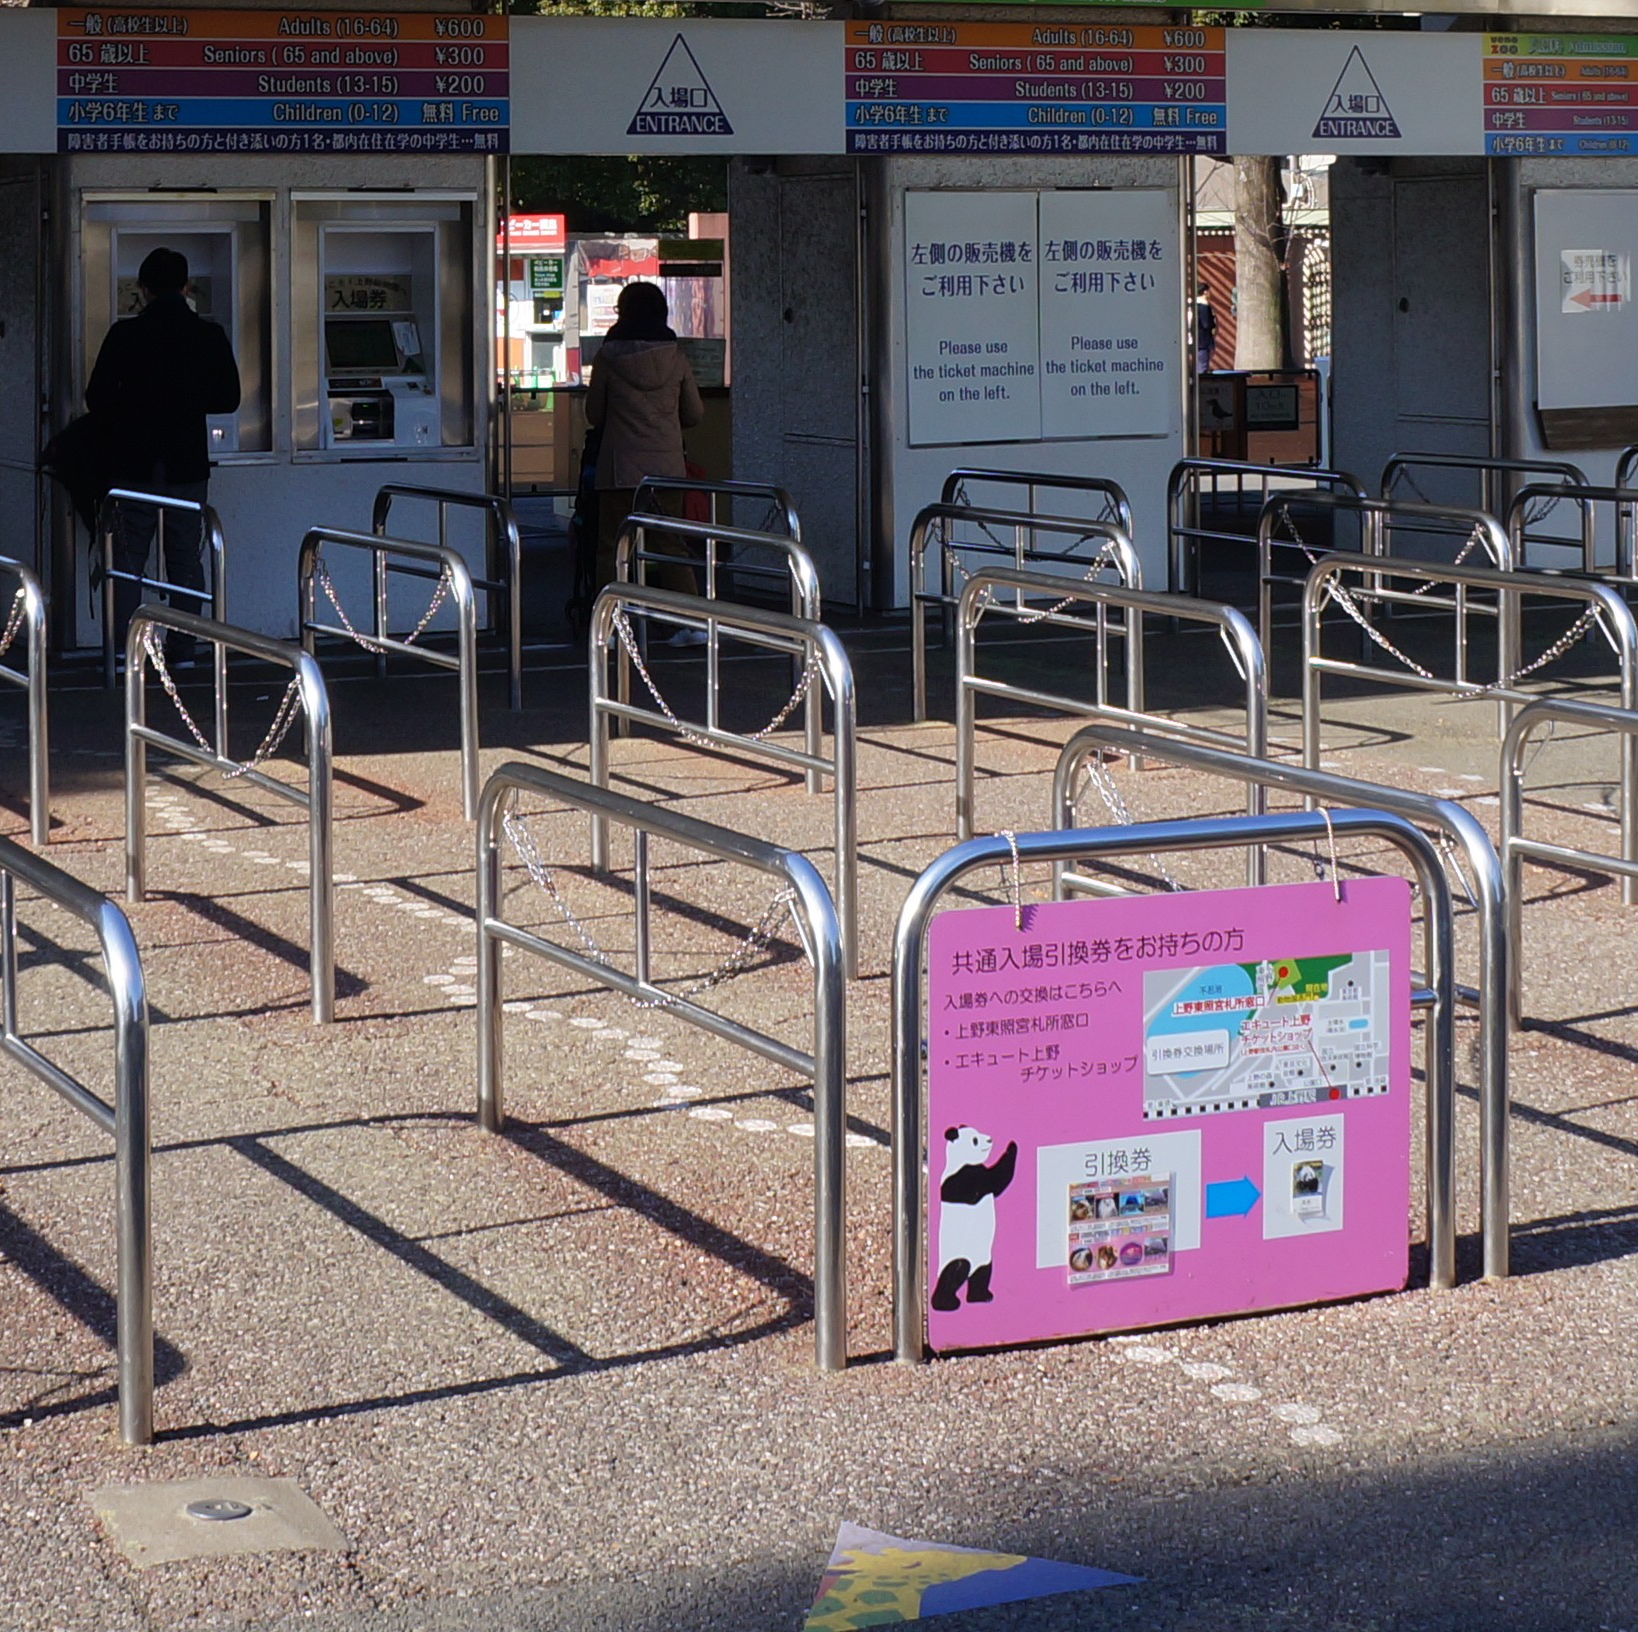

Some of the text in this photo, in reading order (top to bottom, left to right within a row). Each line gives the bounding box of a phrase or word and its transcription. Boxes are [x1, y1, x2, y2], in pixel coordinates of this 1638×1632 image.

[69, 15, 101, 32] 一般
[279, 17, 330, 36] Adults
[337, 18, 399, 38] (16-64)
[435, 19, 484, 38] ¥600
[855, 27, 883, 43] 一般
[1033, 29, 1076, 45] Adults
[1081, 30, 1133, 47] (16-64)
[1164, 31, 1205, 47] ¥600
[68, 45, 93, 63] 65
[100, 45, 150, 64] 歳以上
[204, 46, 265, 64] Seniors
[311, 47, 339, 64] and
[345, 47, 399, 67] above)
[435, 48, 484, 66] ¥300
[855, 53, 876, 69] 65
[882, 53, 923, 70] 歳以上
[970, 54, 1022, 70] Seniors
[1060, 56, 1084, 71] and
[1089, 56, 1133, 73] above)
[1164, 57, 1205, 73] ¥300
[69, 74, 484, 95] 中学生 Students (13-15) ¥200
[855, 79, 1205, 99] 中学生 Students (13-15) ¥200
[651, 87, 708, 108] 入場口
[1331, 94, 1380, 113] 入場口
[1492, 88, 1508, 102] 65
[274, 104, 342, 122] Children
[348, 105, 399, 124] (0-12)
[423, 103, 453, 123] 無料
[462, 105, 498, 122] Free
[1028, 108, 1085, 124] Children
[1091, 108, 1133, 126] (0-12)
[1153, 108, 1179, 126] 無料
[1187, 108, 1216, 124] Free
[1492, 113, 1525, 128] 中学生
[637, 116, 724, 132] ENTRANCE
[1320, 120, 1394, 136] ENTRANCE
[911, 241, 1032, 265] 左側の販売機を
[1045, 239, 1162, 262] 左側の販売機を
[922, 274, 1024, 297] ご利用下さい
[1054, 271, 1155, 294] ご利用下さい
[939, 340, 1008, 355] Please use
[1071, 336, 1138, 351] Please use
[913, 362, 1035, 379] the ticket machine
[1046, 358, 1164, 374] the ticket machine
[939, 385, 1010, 401] on the left.
[1071, 380, 1139, 396] on the left.
[952, 927, 1245, 976] 共通入場引換券をお持ちの方
[944, 978, 1122, 1012] 入場券への交換はこちらへ
[1241, 1014, 1311, 1031] エキュート上野
[1241, 1028, 1312, 1045] チケットショップ
[1020, 1055, 1138, 1084] チケットショップ
[1273, 1127, 1336, 1155] 入場券
[1084, 1147, 1152, 1178] 引換券
